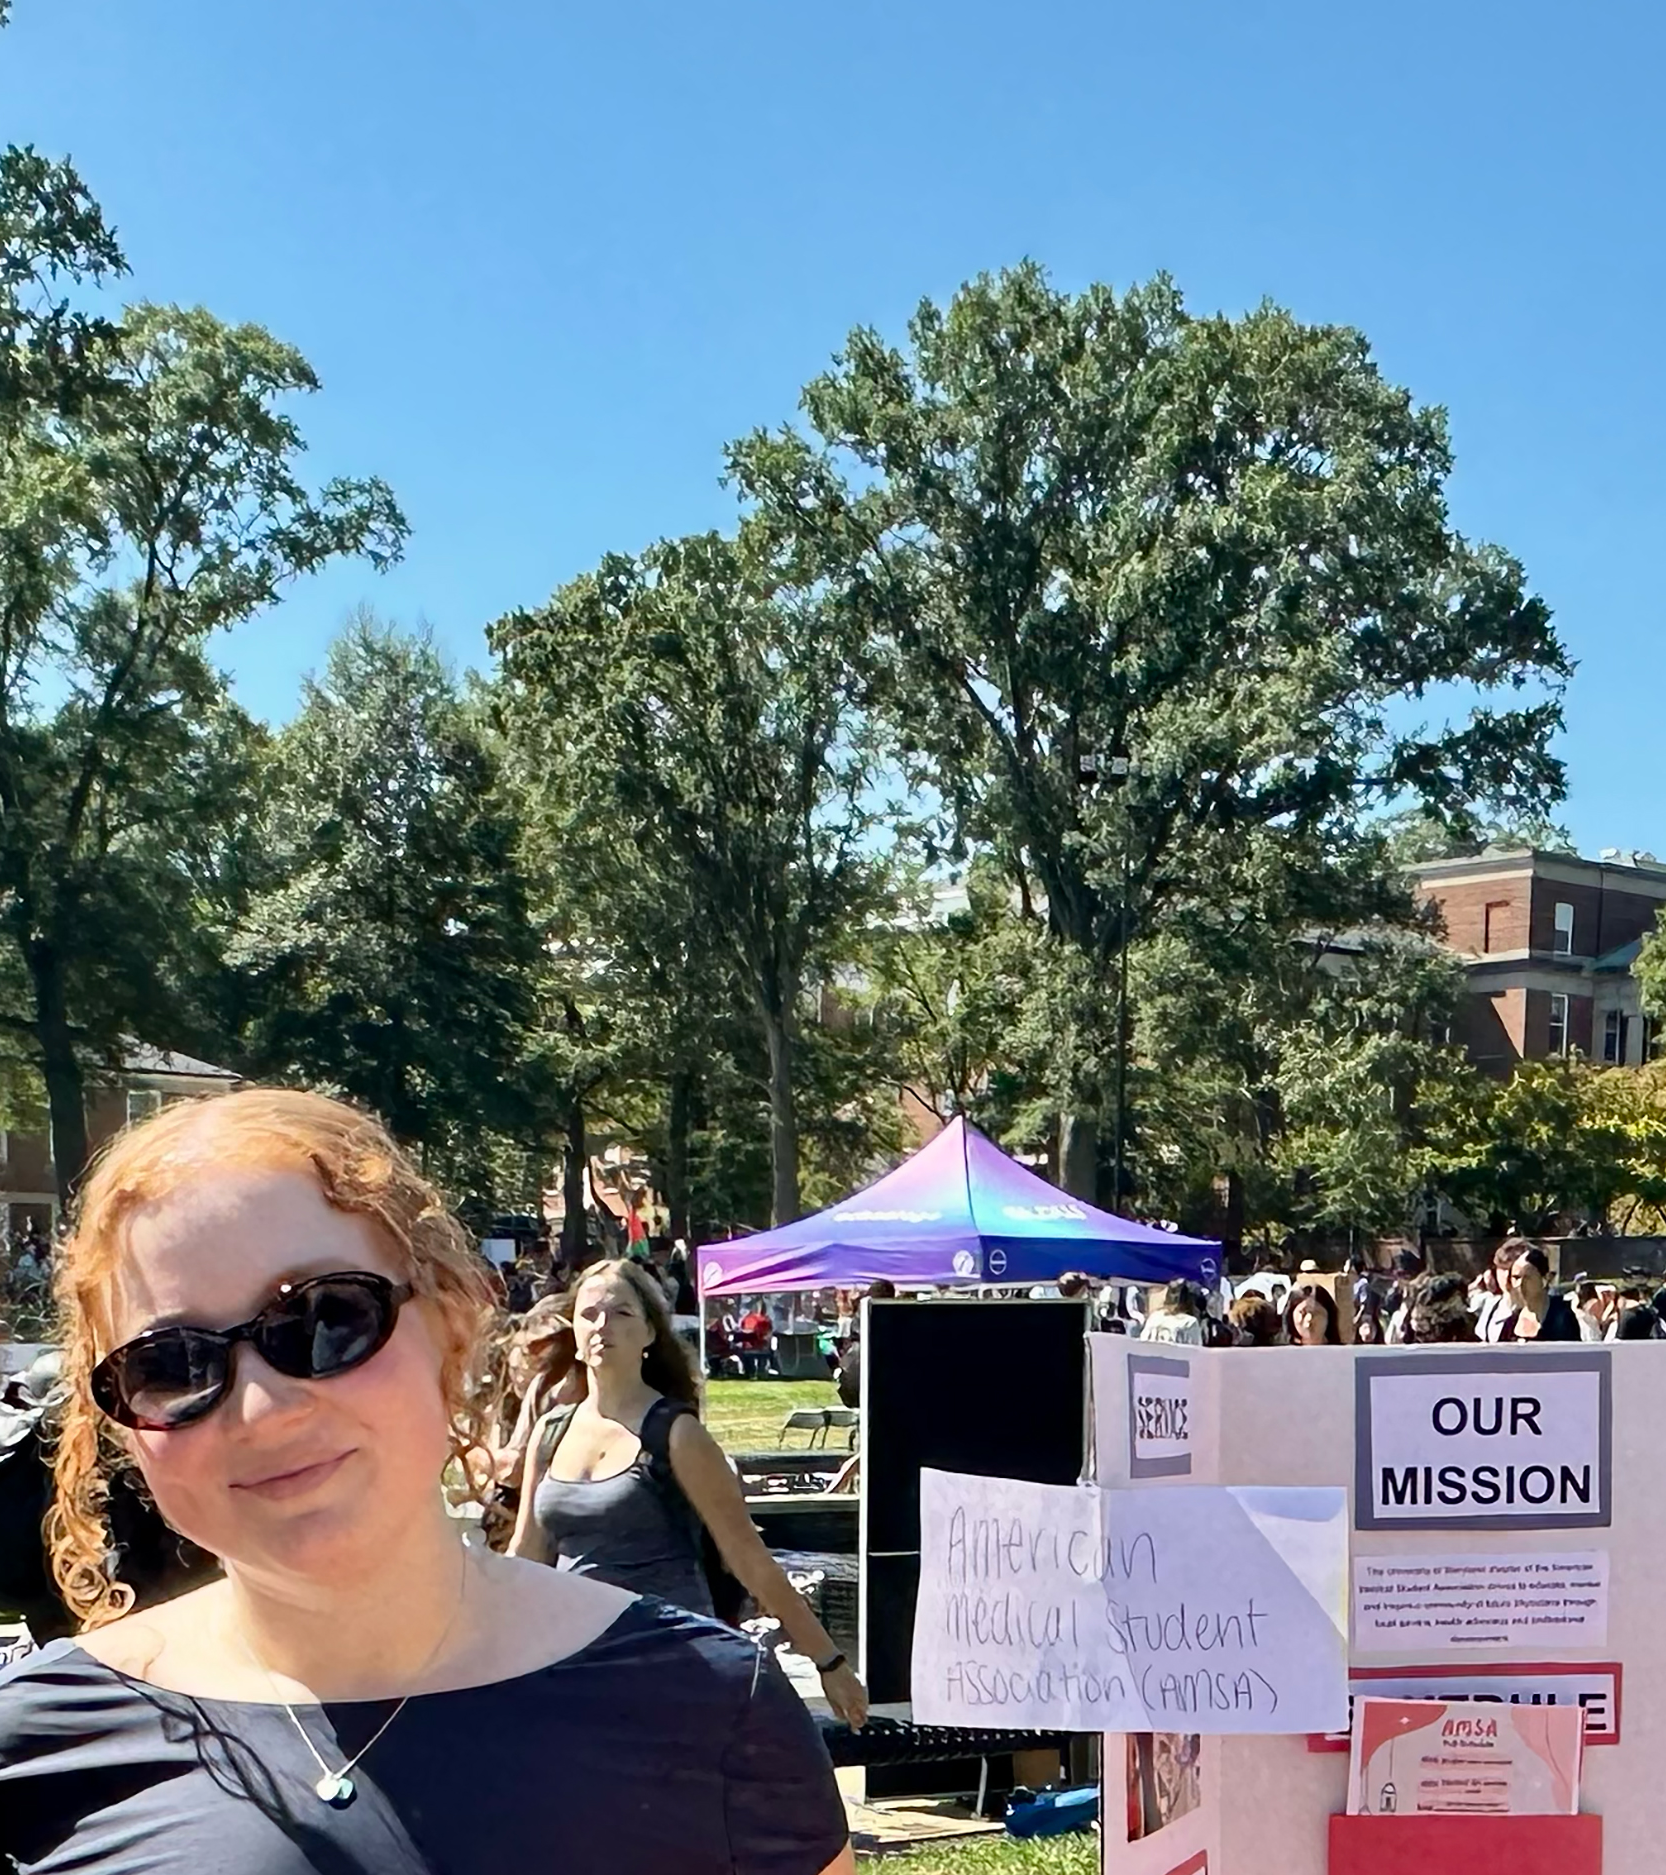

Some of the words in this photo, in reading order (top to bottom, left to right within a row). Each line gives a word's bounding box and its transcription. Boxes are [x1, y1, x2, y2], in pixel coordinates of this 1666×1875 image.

[1432, 1396, 1542, 1436] OUR
[1382, 1465, 1591, 1505] MISSION
[947, 1506, 1157, 1584] American
[1107, 1597, 1268, 1654] Student
[1142, 1667, 1278, 1714] (AMSA)
[1441, 1717, 1498, 1737] AMSA
